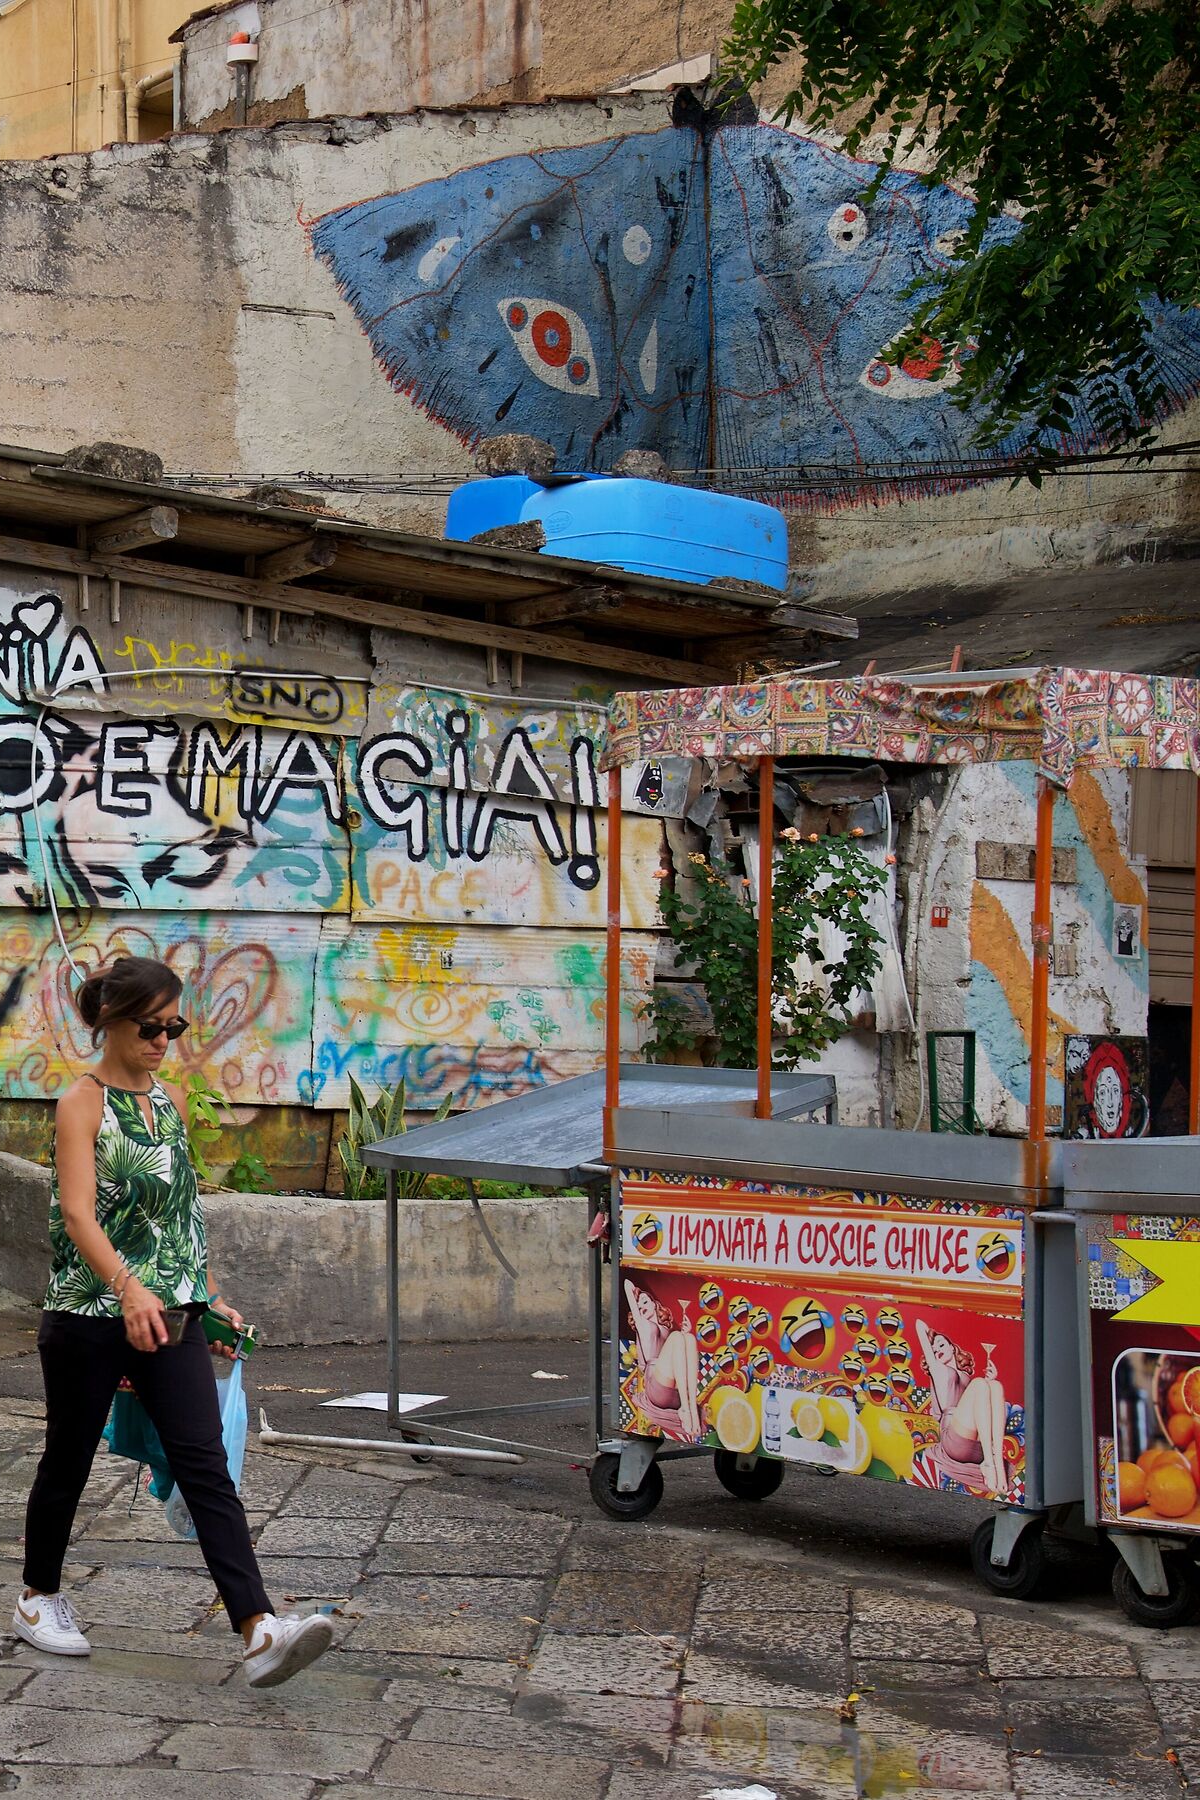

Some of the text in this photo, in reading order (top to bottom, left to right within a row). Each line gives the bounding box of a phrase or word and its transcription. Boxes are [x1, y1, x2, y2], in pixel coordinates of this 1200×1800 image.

[668, 1214, 969, 1275] LIMONATA A COSCIE CHIUSE
